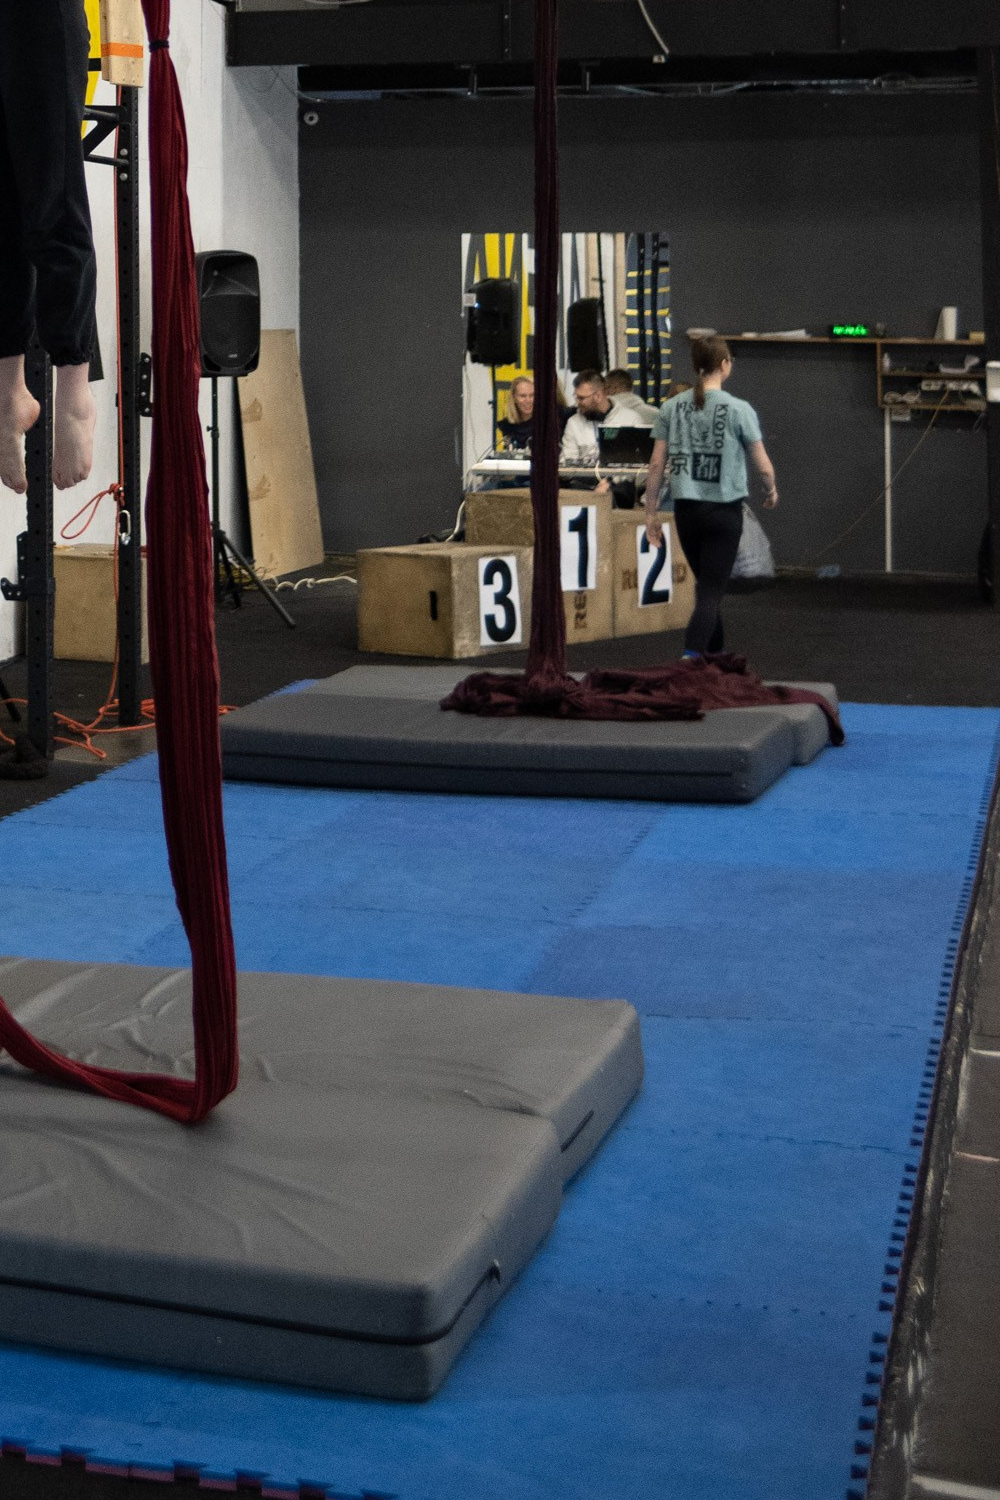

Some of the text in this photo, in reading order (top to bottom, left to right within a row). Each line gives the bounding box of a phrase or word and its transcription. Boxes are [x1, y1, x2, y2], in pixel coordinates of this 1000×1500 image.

[713, 403, 729, 449] KYOTO
[567, 507, 589, 588] 1
[639, 526, 670, 605] 2
[482, 557, 517, 643] 3
